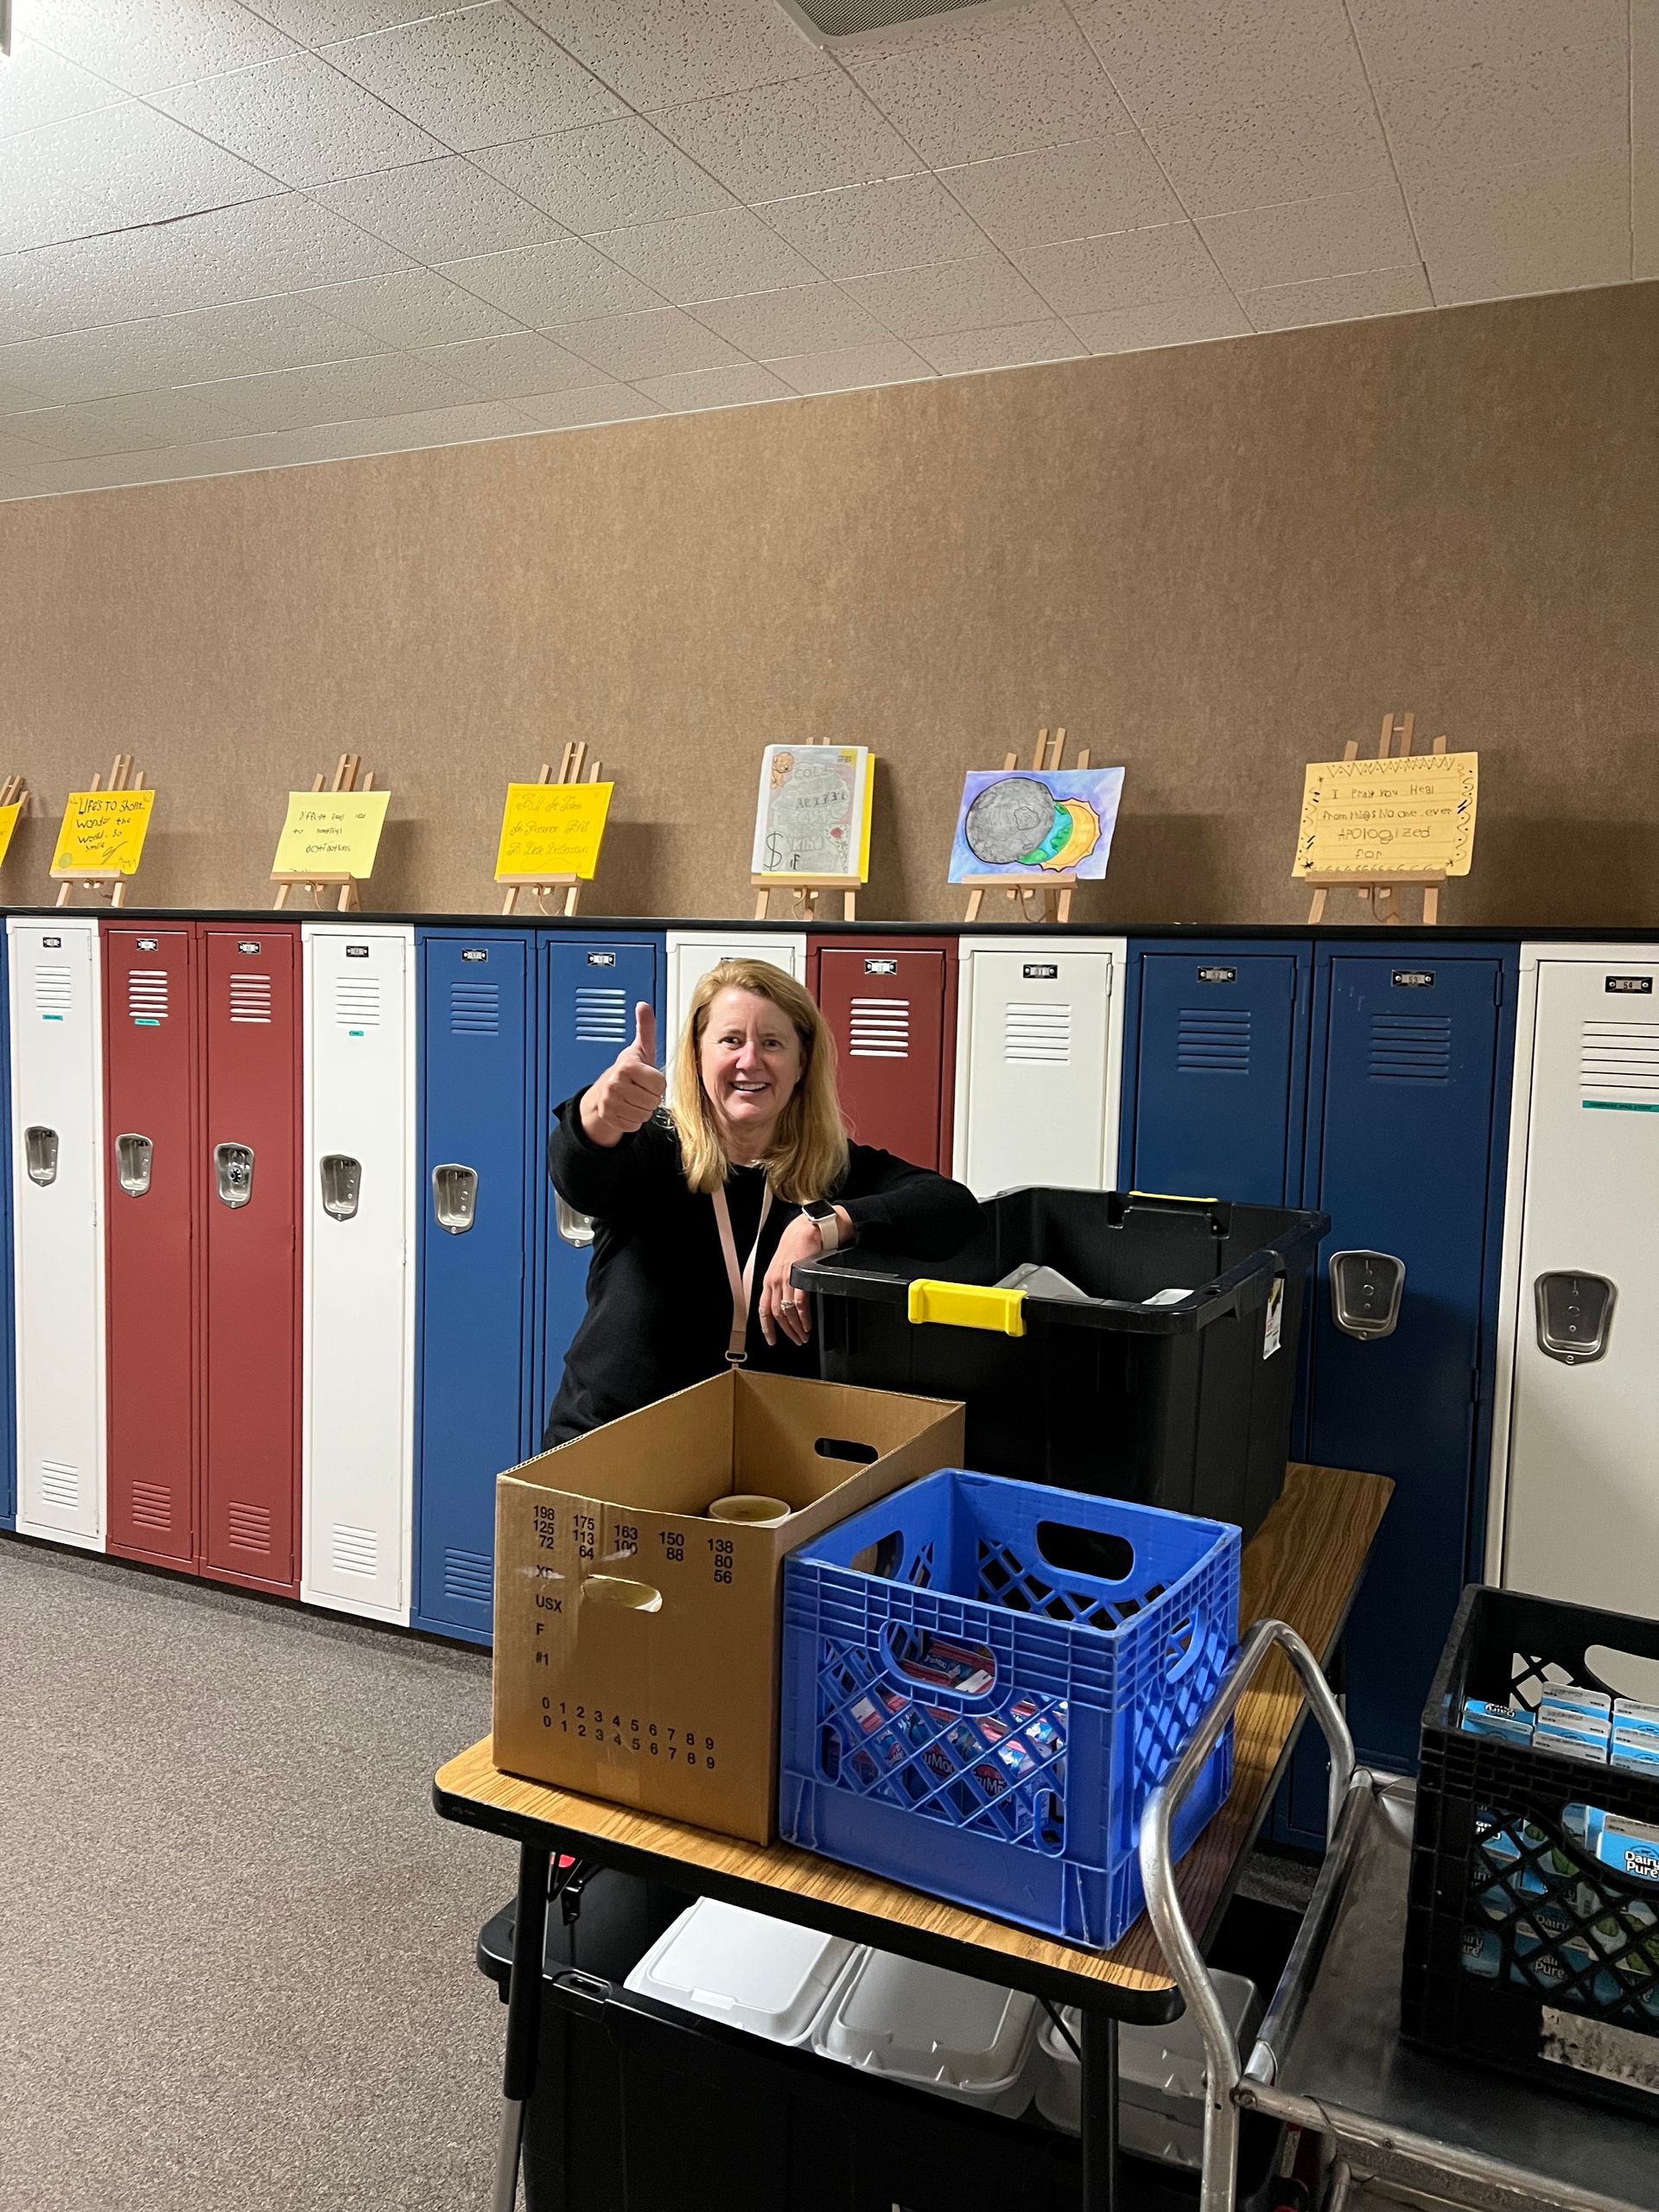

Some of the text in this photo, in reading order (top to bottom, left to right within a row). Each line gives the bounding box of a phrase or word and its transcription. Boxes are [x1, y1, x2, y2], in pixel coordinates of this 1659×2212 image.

[533, 1505, 734, 1554] 198 175 163 150 138
[533, 1520, 555, 1535] 125
[573, 1529, 594, 1545] 113
[666, 1548, 684, 1561] 88
[715, 1554, 734, 1569] 80
[539, 1535, 733, 1585] 72 64 56
[536, 1594, 562, 1614] USX
[536, 1623, 544, 1637] F
[536, 1652, 550, 1666] #1
[542, 1697, 715, 1751] 0 1 2 3 4 5 6 7 8 9
[543, 1715, 715, 1770] 0 1 2 3 4 5 6 7 8 9
[1626, 1860, 1659, 1878] Pure
[1535, 1961, 1565, 1979] Pure
